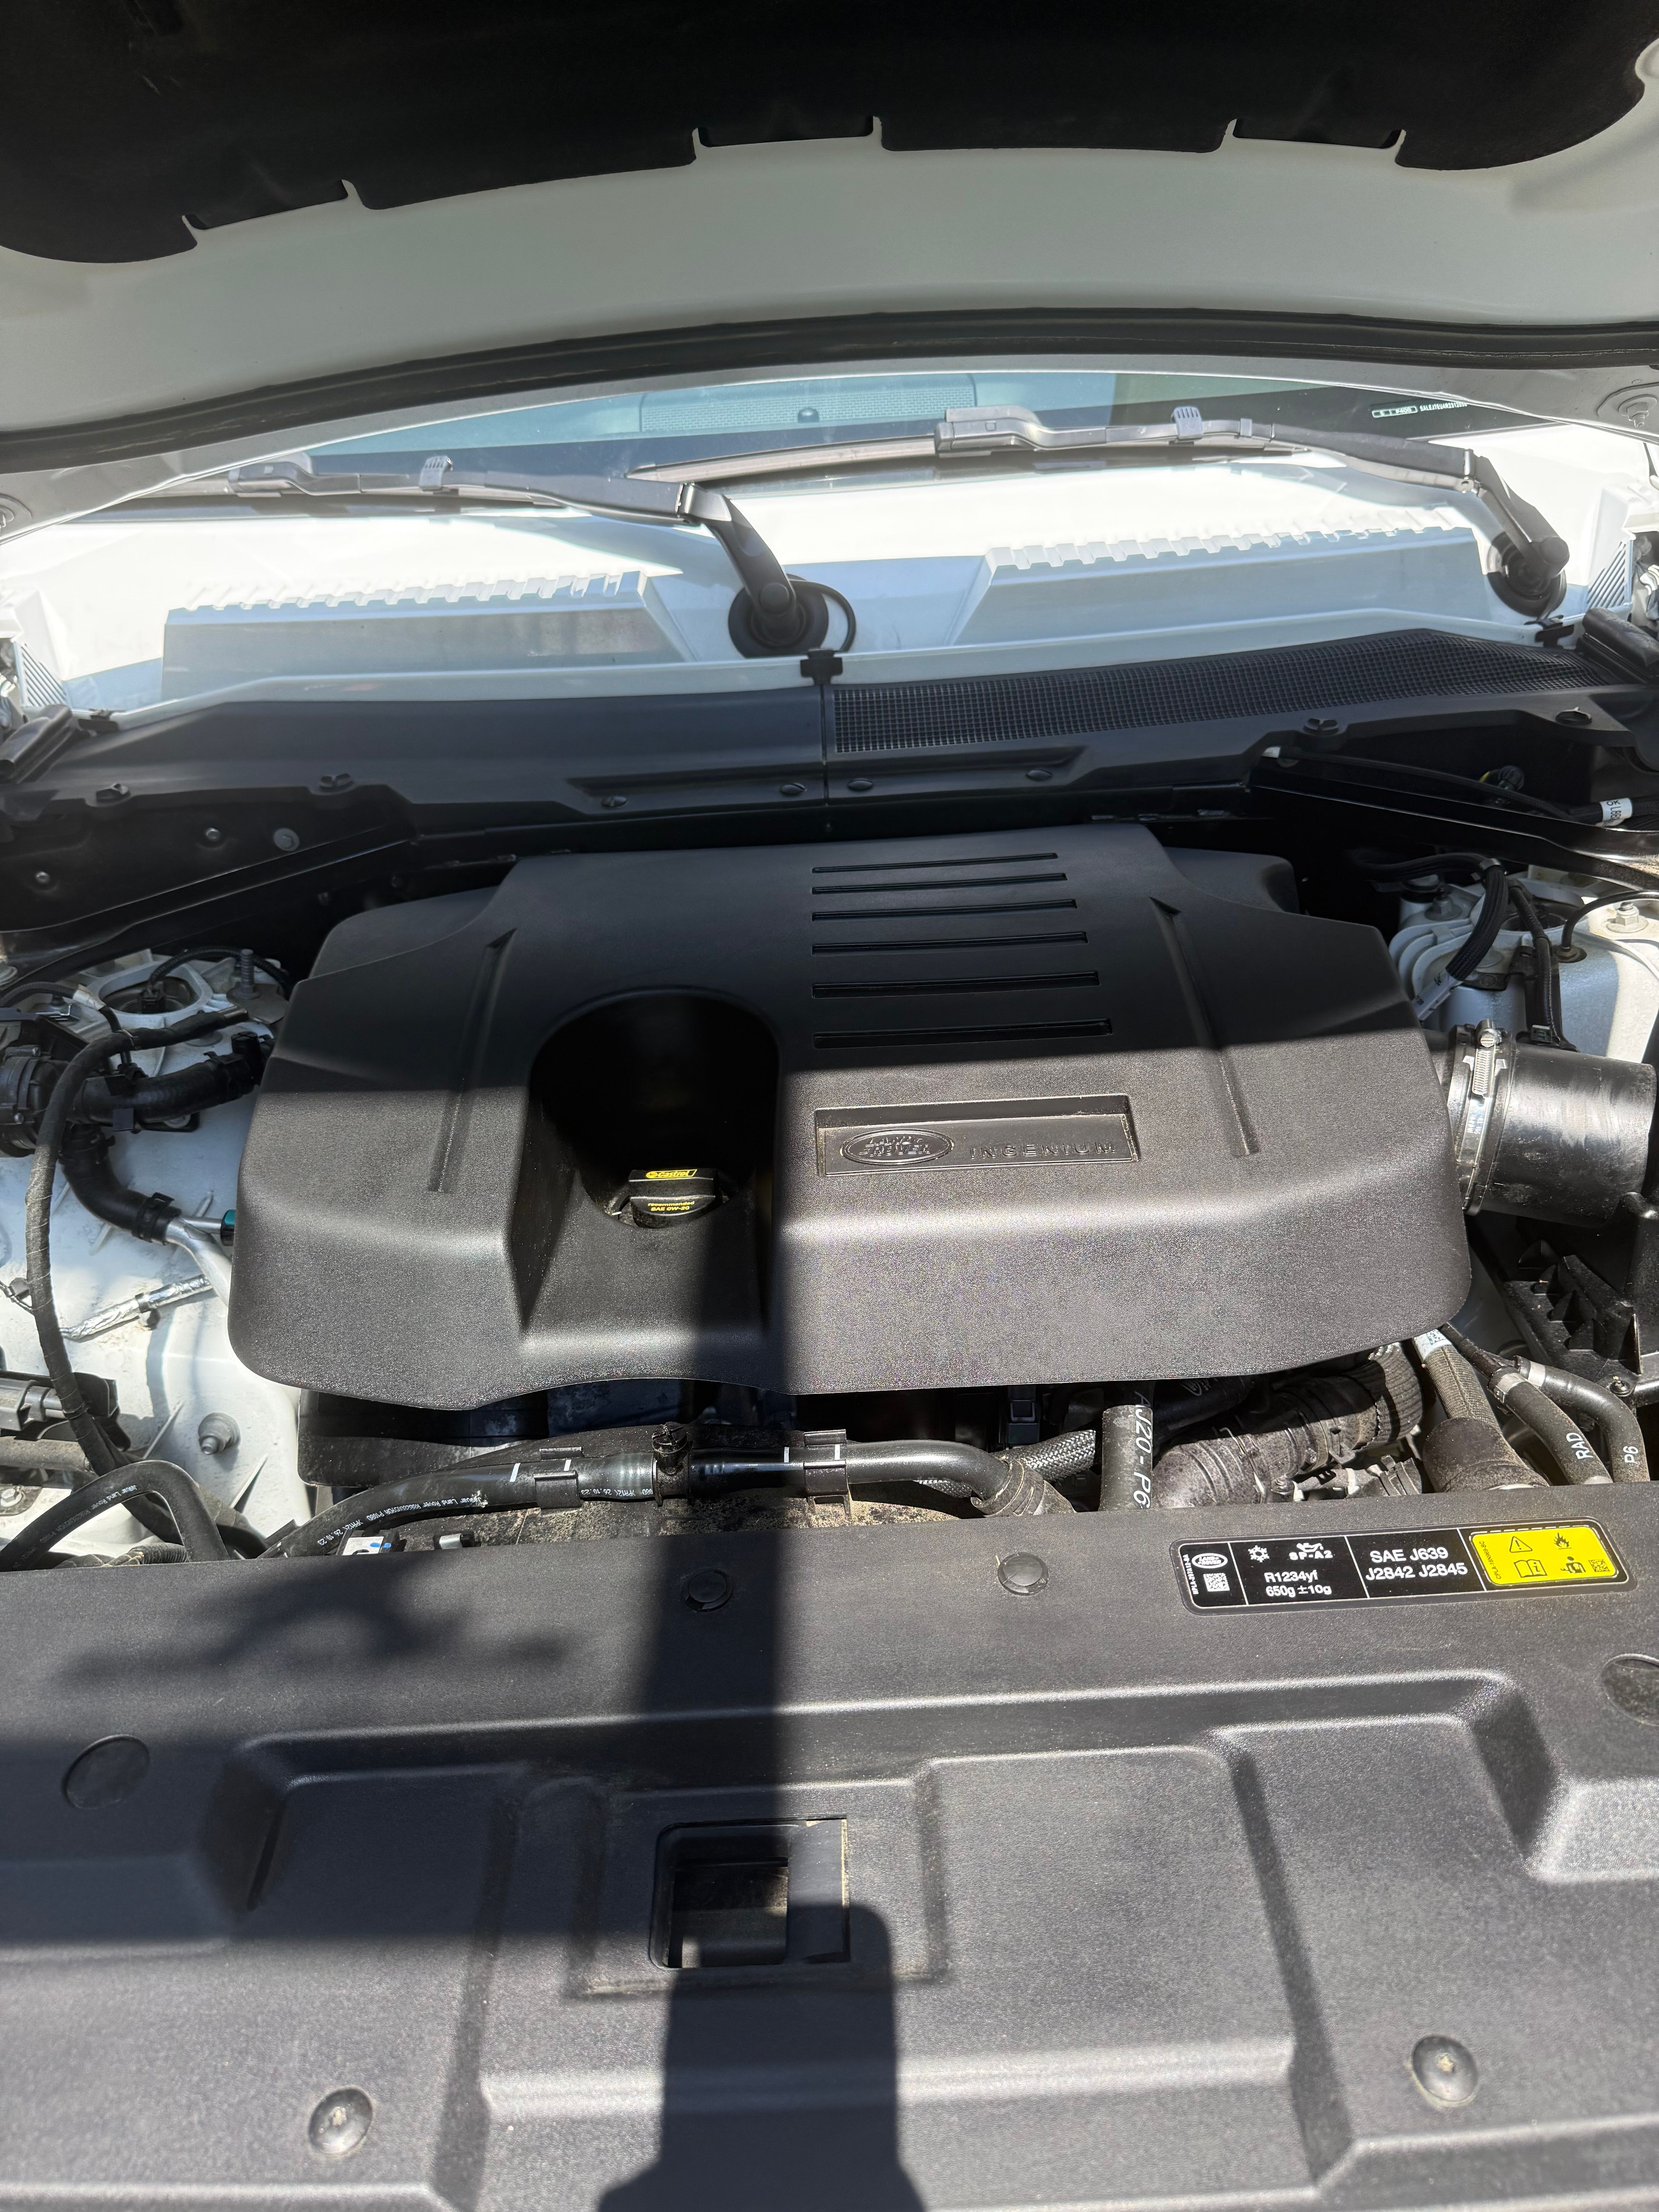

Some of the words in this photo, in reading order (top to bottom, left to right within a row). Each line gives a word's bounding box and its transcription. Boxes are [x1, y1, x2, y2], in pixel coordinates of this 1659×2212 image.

[970, 1142, 1116, 1159] INGENIUM
[1135, 1391, 1152, 1454] AJ20
[1566, 1432, 1594, 1460] RAD
[1623, 1446, 1638, 1464] P6
[91, 1498, 108, 1510] Rover
[106, 1491, 122, 1501] Land
[1289, 1550, 1333, 1560] SP-A2
[1369, 1549, 1407, 1563] SAE
[1410, 1547, 1448, 1561] J639
[1264, 1570, 1318, 1583] R1234yf
[1365, 1566, 1416, 1580] J2842
[1419, 1562, 1468, 1577] J2845
[1266, 1585, 1296, 1598] 650g
